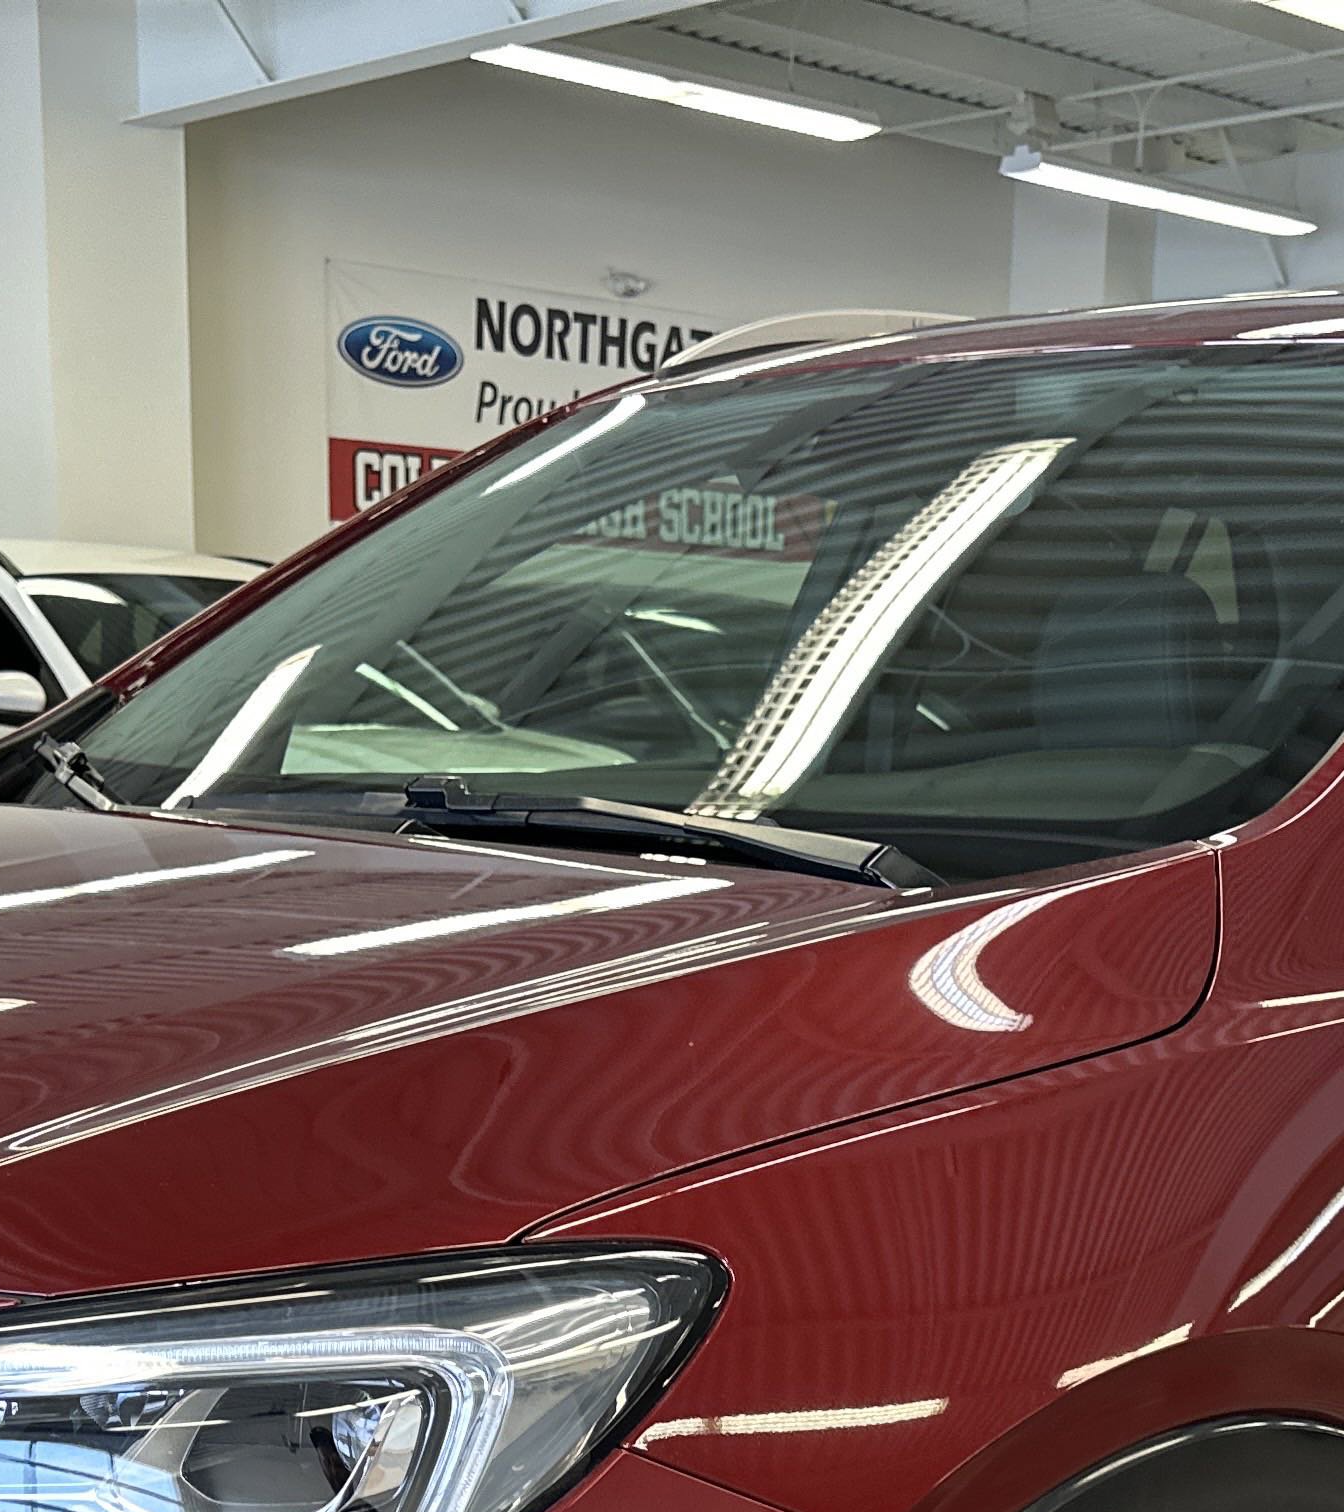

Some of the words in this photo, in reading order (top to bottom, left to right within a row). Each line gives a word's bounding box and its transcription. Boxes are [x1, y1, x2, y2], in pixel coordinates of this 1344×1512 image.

[358, 322, 443, 380] Ford
[474, 297, 719, 373] NORTHGA
[475, 380, 580, 426] Prou
[659, 488, 785, 551] SCHOOL
